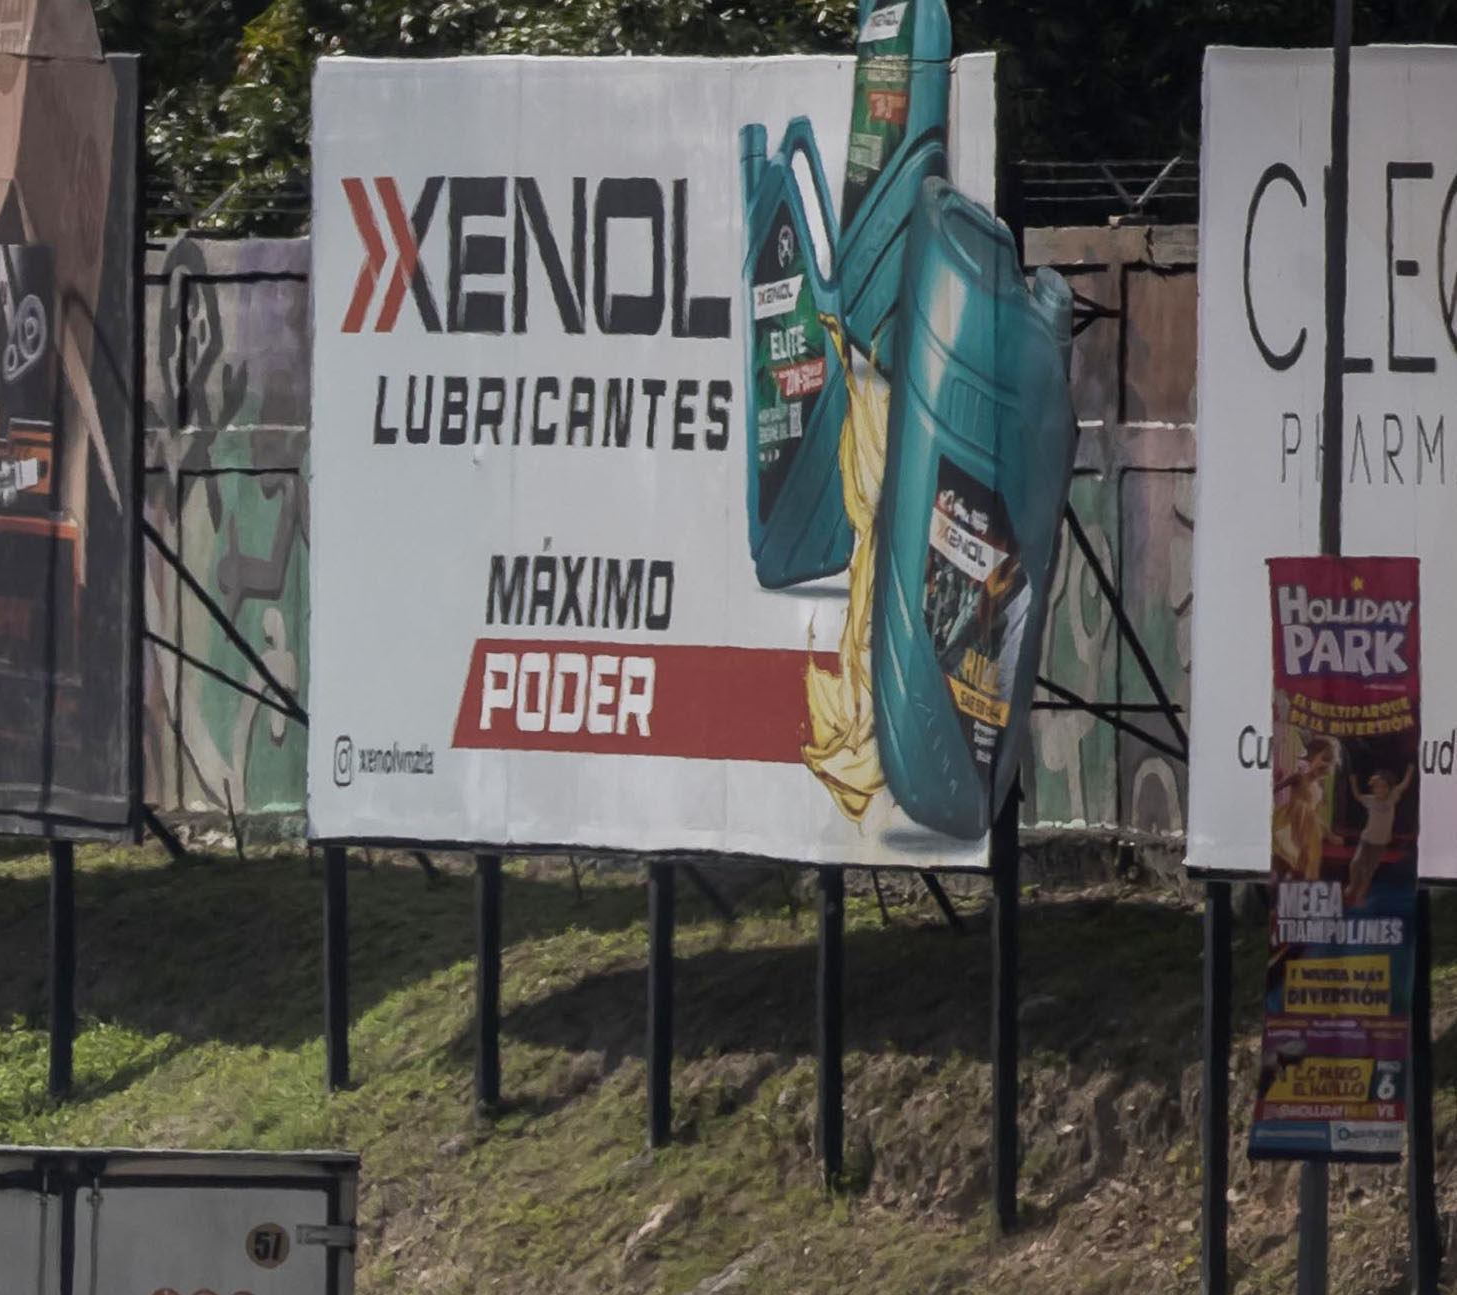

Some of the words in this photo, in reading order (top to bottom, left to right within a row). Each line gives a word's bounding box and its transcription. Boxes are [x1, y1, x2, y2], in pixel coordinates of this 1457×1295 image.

[340, 175, 732, 340] XENOL
[372, 374, 734, 452] LUBRICANTES
[484, 536, 675, 631] MÁXIMO
[1277, 584, 1414, 626] HOLLIDAY
[1281, 625, 1410, 677] PARK
[478, 651, 657, 738] PODER
[1277, 880, 1343, 918] MEGA
[1277, 917, 1404, 945] TRAMPOLINES
[1377, 1073, 1396, 1101] 6
